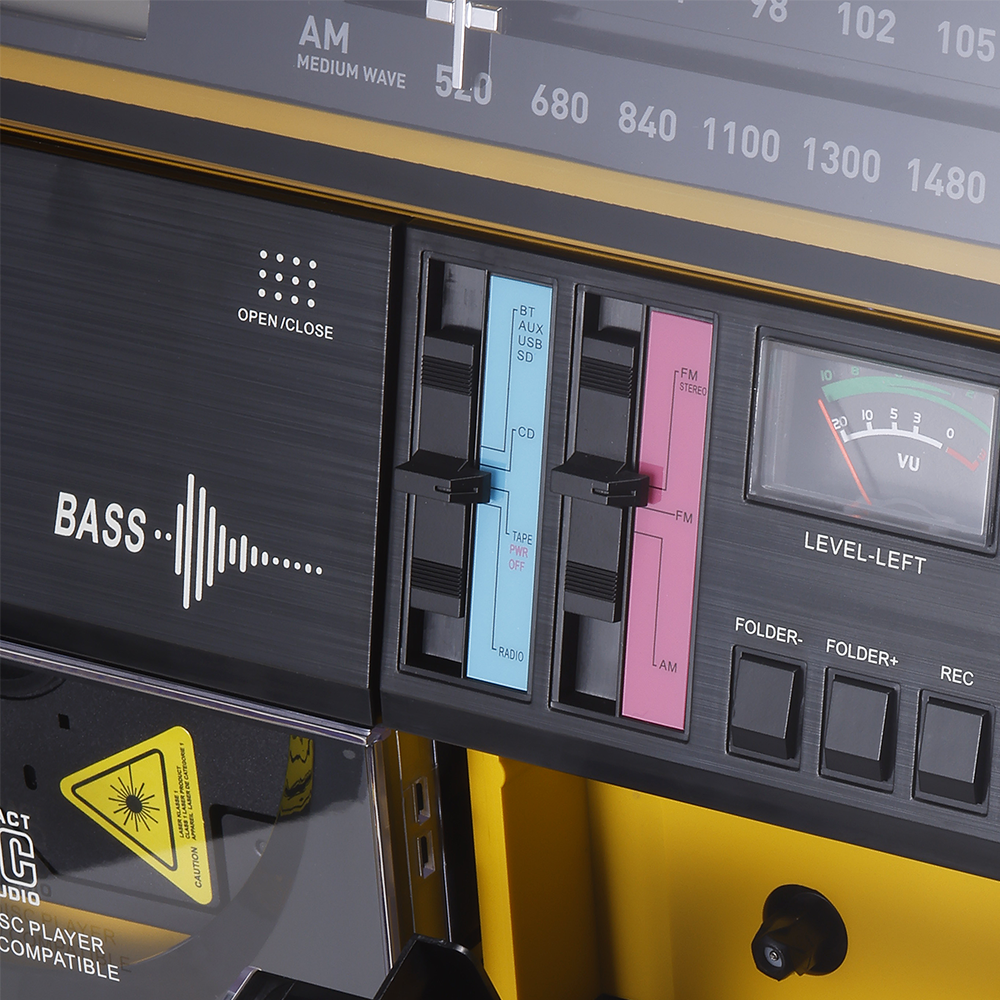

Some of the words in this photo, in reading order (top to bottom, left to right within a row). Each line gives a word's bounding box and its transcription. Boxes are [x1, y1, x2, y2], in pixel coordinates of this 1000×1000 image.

[299, 14, 349, 55] AM
[750, 0, 788, 23] 98
[837, 2, 896, 45] 102
[938, 21, 996, 62] 105
[297, 53, 359, 80] MEDIUM
[363, 66, 407, 89] WAVE
[531, 84, 589, 124] 680
[618, 101, 677, 142] 840
[703, 117, 780, 163] 1100
[802, 137, 881, 184] 1300
[907, 158, 986, 204] 1480
[520, 305, 535, 317] BT
[518, 320, 544, 335] AUX
[518, 336, 543, 350] USB
[516, 350, 534, 363] SD
[680, 367, 698, 381] FM
[821, 369, 833, 382] 10
[679, 382, 707, 397] STEREO
[518, 426, 535, 439] CD
[831, 416, 848, 430] 20
[862, 409, 874, 421] 10
[890, 408, 899, 420] 5
[913, 411, 922, 424] 3
[946, 427, 955, 439] 0
[897, 452, 921, 472] VU
[54, 491, 147, 553] BASS
[675, 510, 693, 524] FM
[512, 530, 533, 546] TAPE
[509, 544, 529, 558] PWR
[804, 531, 927, 575] LEVEL-LEFT
[508, 559, 526, 572] OFF
[734, 616, 804, 647] FOLDER-
[498, 646, 524, 663] RADIO
[825, 638, 899, 667] FOLDER+
[658, 660, 678, 673] AM
[940, 664, 974, 687] REC
[176, 766, 184, 794] PRODUCT
[185, 790, 193, 810] LASER
[177, 819, 185, 838] LASER
[183, 820, 191, 839] CLASS
[192, 847, 203, 888] CAUTION
[29, 920, 105, 954] PLAYER
[0, 936, 120, 982] COMPATIBLE
